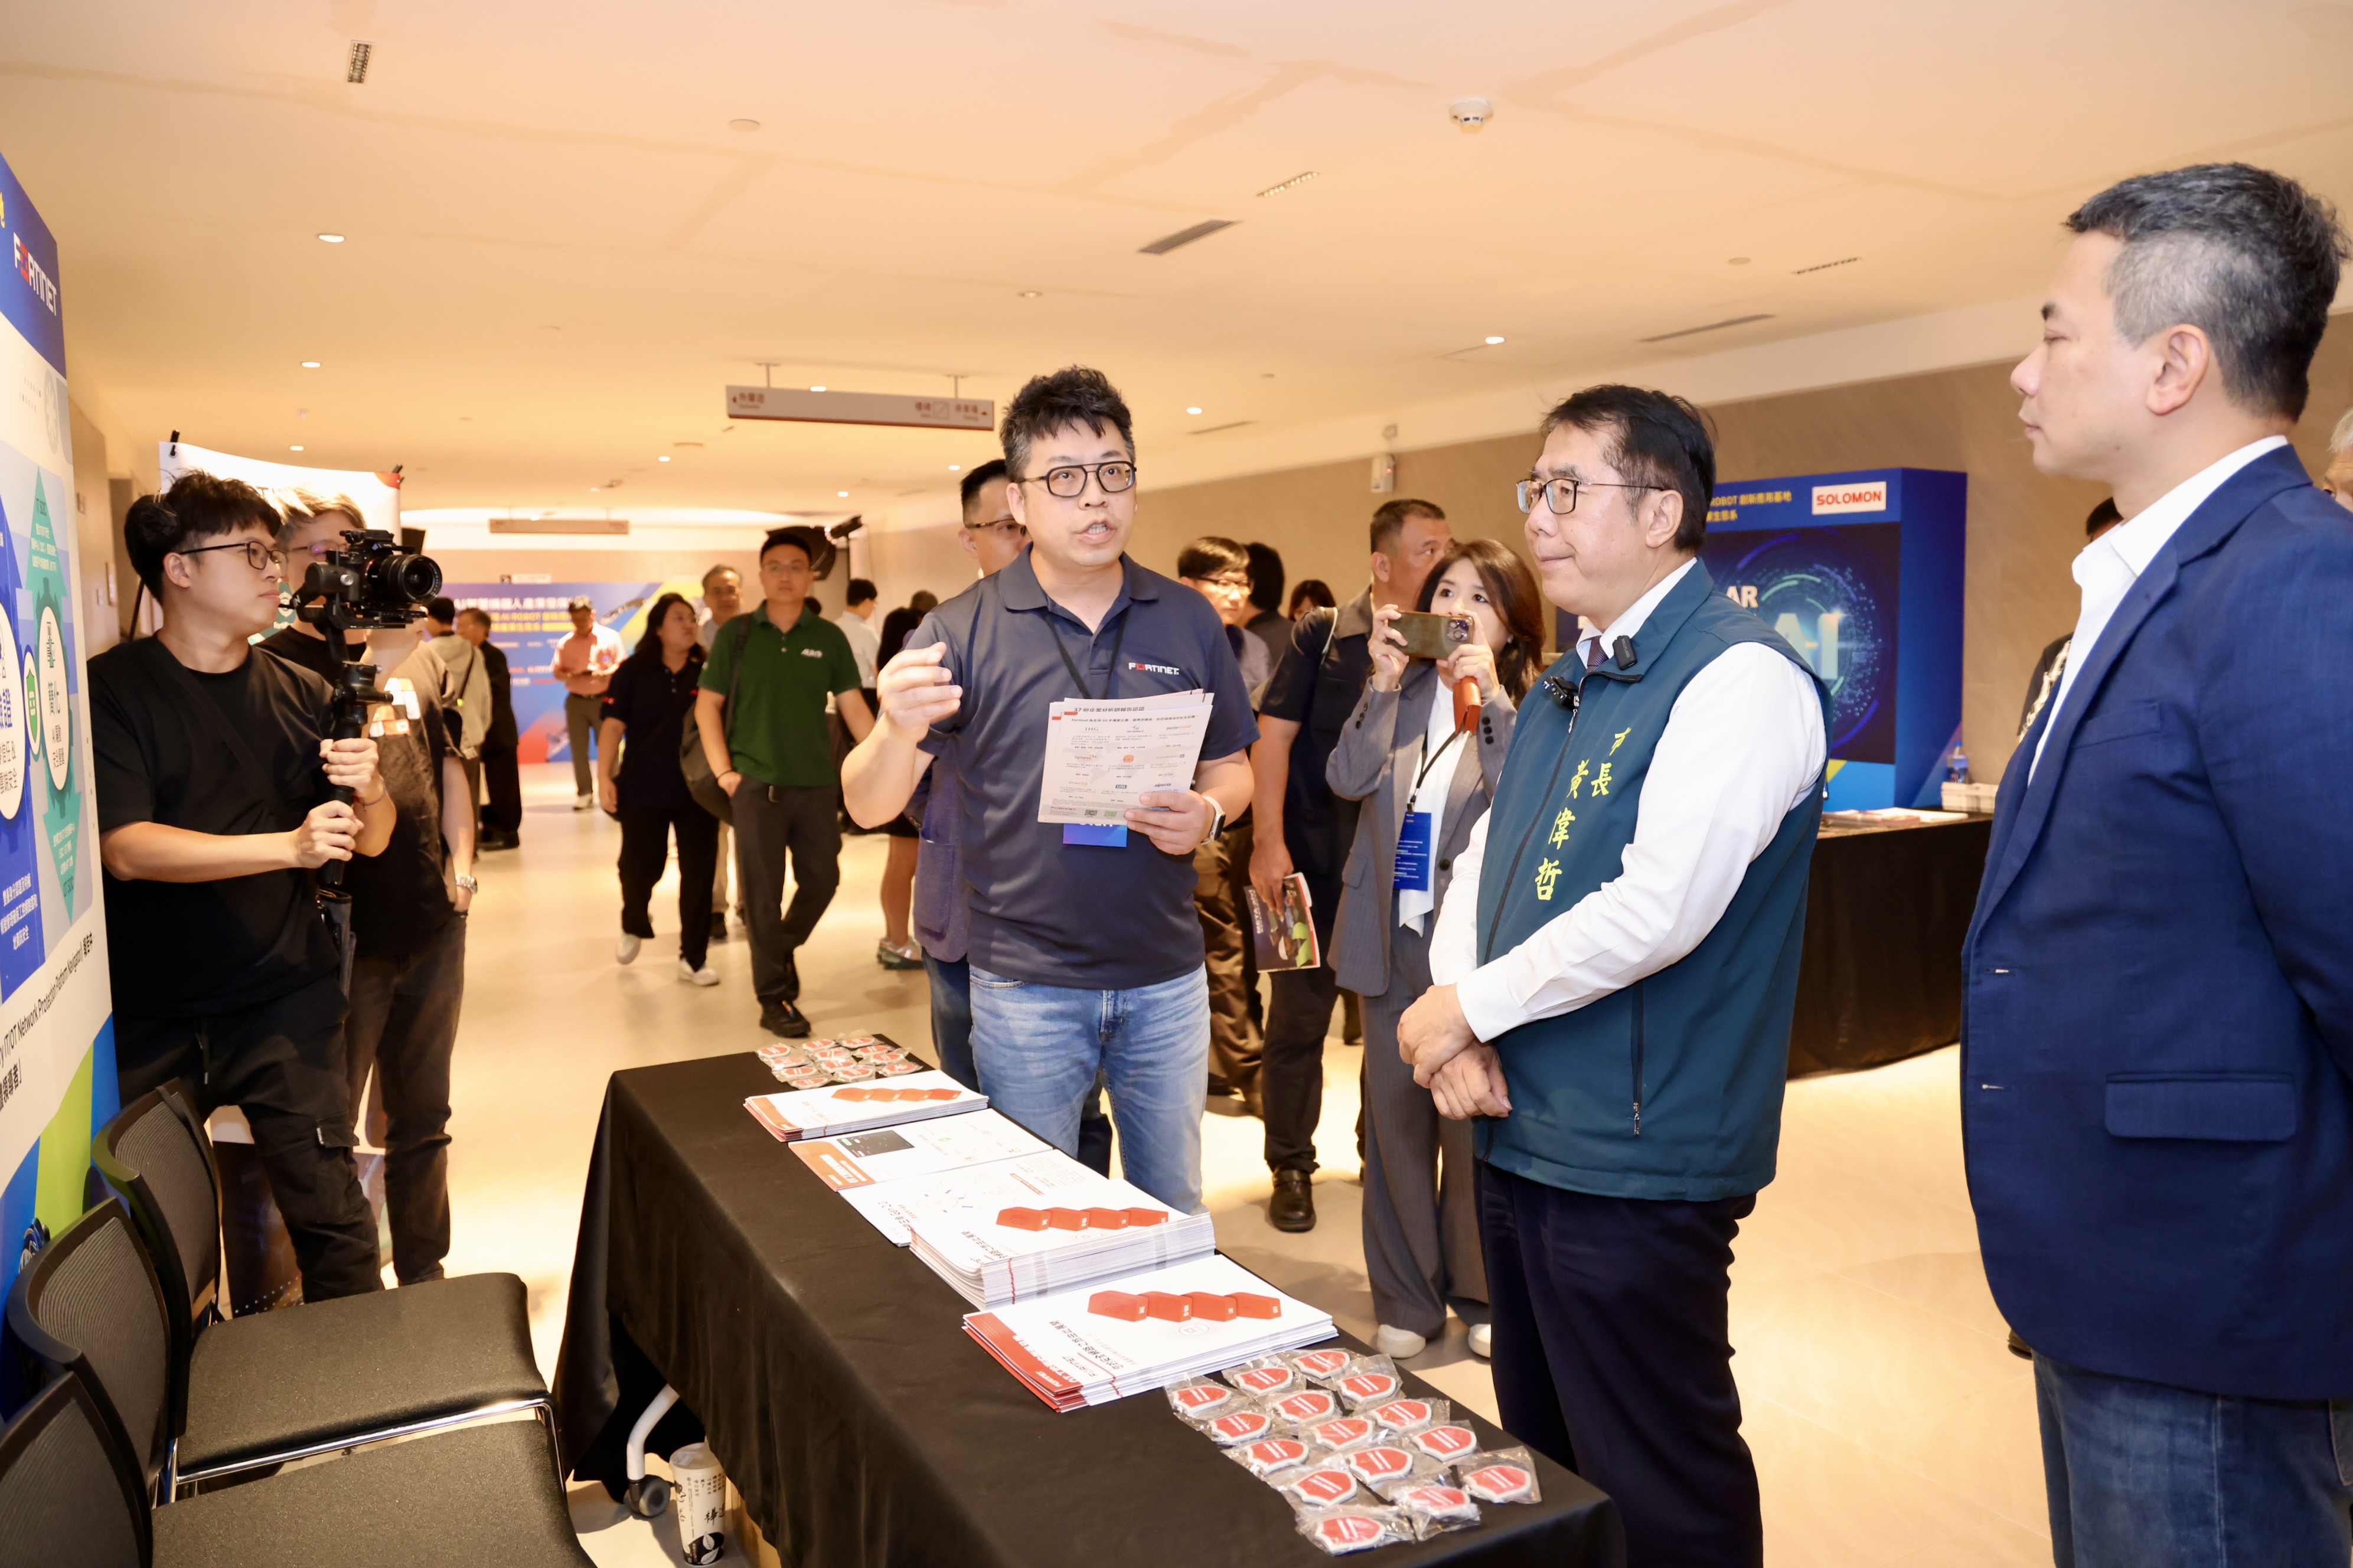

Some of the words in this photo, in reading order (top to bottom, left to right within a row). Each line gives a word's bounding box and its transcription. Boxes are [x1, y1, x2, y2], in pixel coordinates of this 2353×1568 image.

[14, 232, 57, 316] FORTINET
[1816, 490, 1882, 506] SOLOMON
[1128, 662, 1179, 675] FORTINET
[4, 1023, 18, 1058] IT/OT
[17, 1003, 39, 1042] Network
[37, 982, 57, 1020] Protection
[1061, 1355, 1098, 1377] FORTINET
